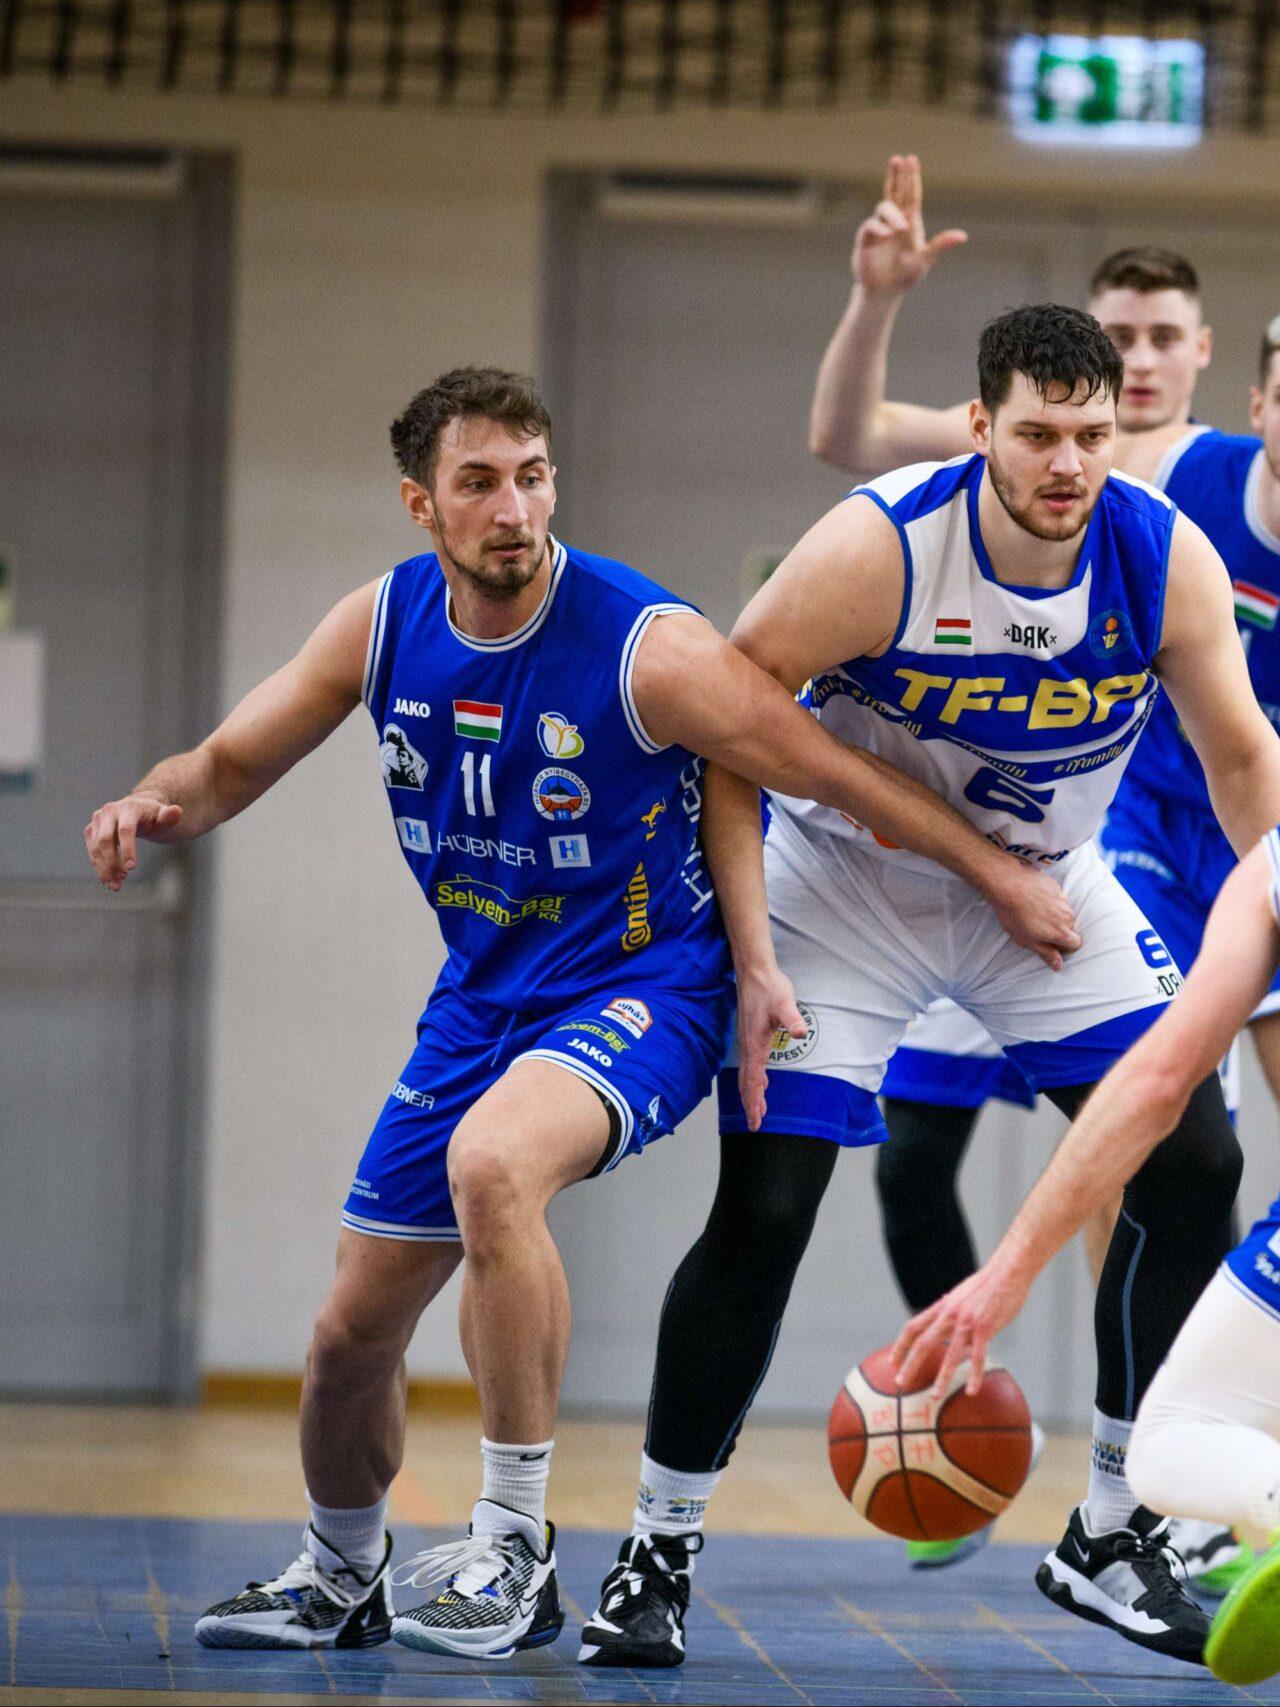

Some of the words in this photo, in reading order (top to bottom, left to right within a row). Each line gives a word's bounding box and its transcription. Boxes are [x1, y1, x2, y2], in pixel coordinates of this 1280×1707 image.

[393, 698, 431, 718] JAKO
[894, 667, 1148, 731] TF-BP
[460, 751, 497, 818] 11
[437, 831, 538, 867] HÜBNER
[437, 884, 567, 924] Selyem-Ber
[1135, 929, 1173, 969] 6
[567, 1038, 613, 1068] JAKO
[769, 1045, 804, 1061] APEST
